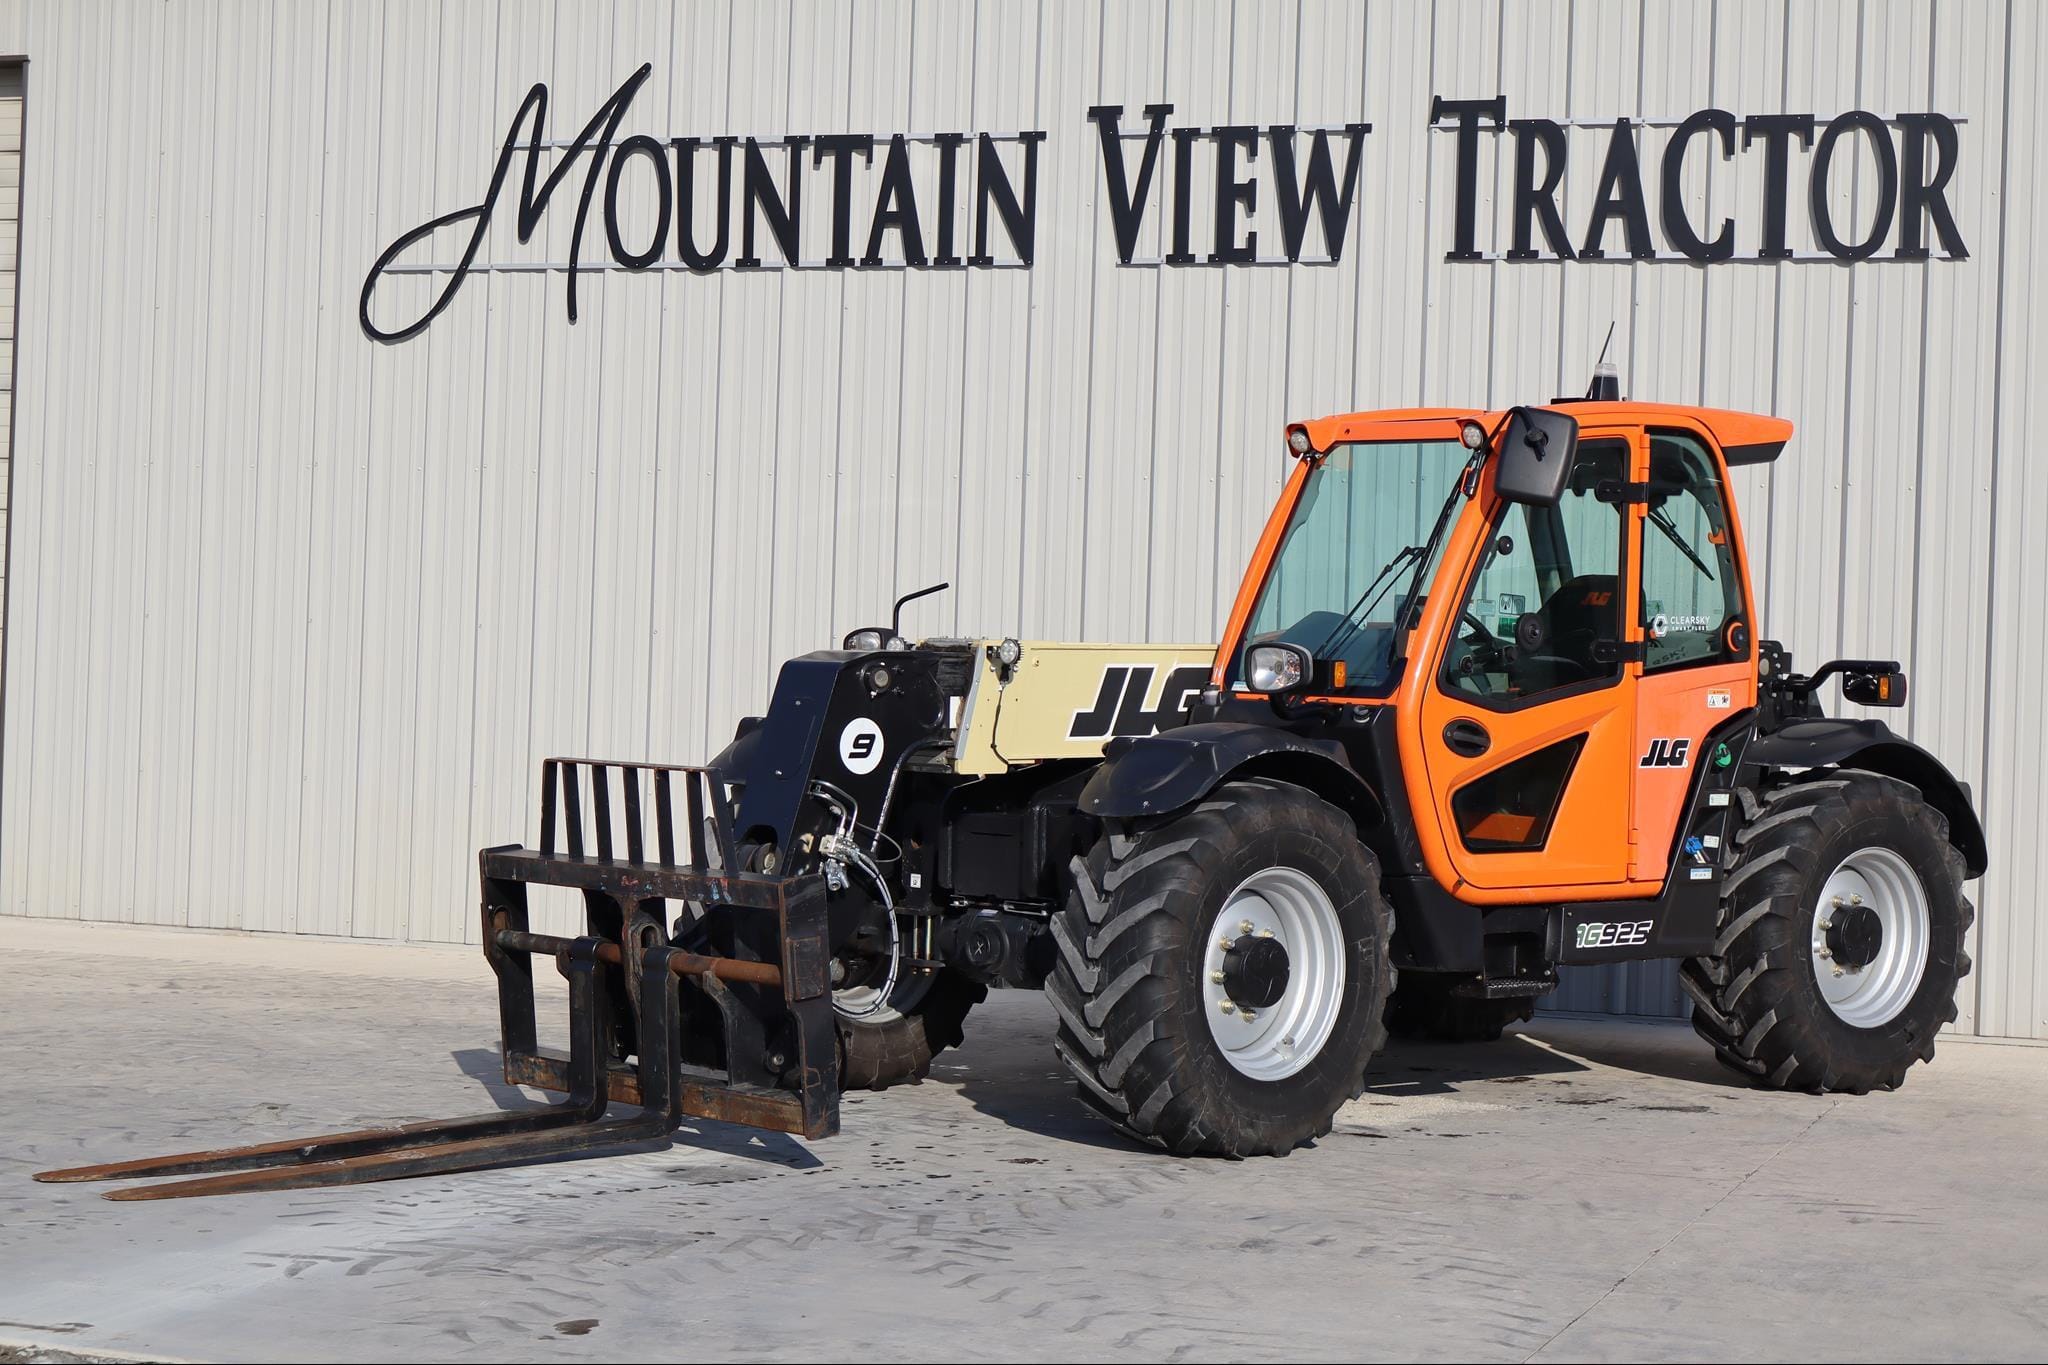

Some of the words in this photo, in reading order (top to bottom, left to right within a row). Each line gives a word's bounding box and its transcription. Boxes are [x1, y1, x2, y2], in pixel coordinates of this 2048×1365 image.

[359, 62, 1047, 343] MOUNTAIN
[1088, 103, 1373, 265] VIEW
[1430, 95, 1969, 263] TRACTOR
[1670, 615, 1711, 625] CLEARSKY
[848, 733, 876, 759] 9
[1640, 739, 1691, 767] JLG
